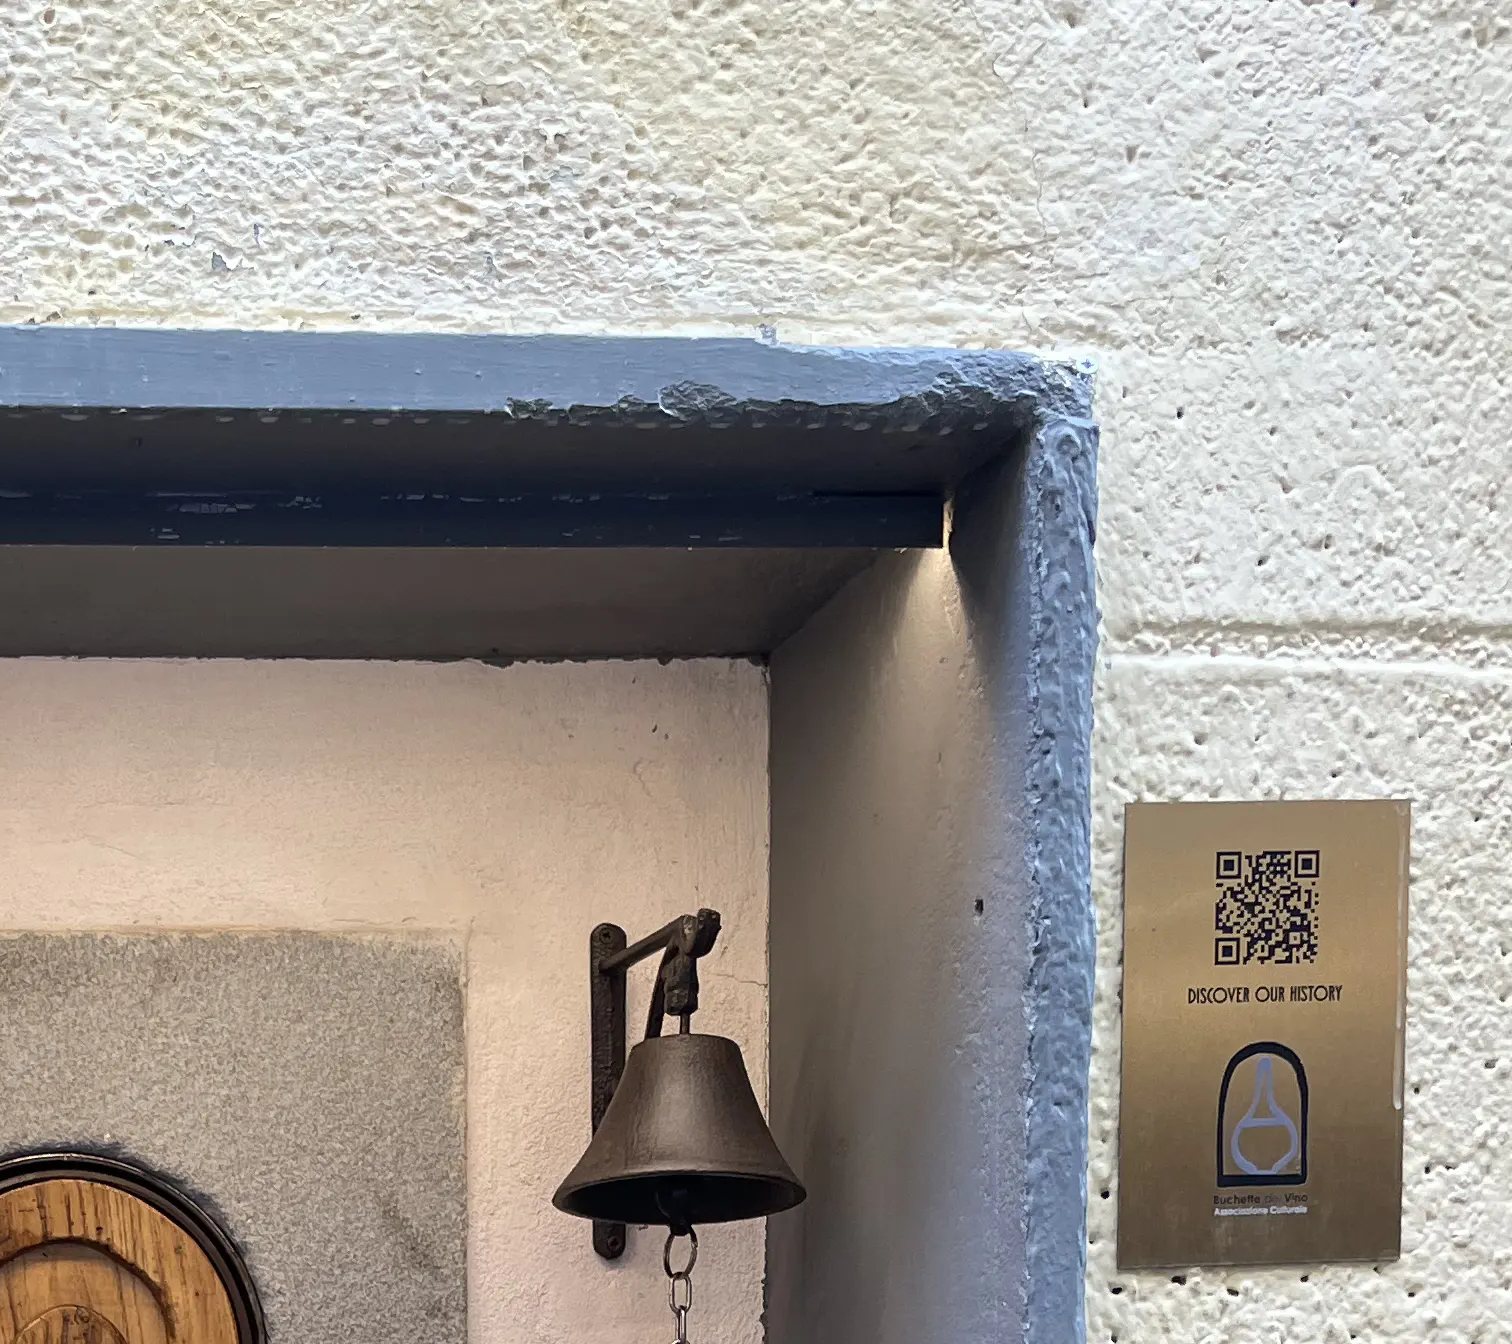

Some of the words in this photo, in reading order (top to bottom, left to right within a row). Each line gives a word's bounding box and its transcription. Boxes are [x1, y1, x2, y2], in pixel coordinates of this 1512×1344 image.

[1188, 987, 1249, 1004] DISCOVER
[1255, 986, 1285, 1003] OUR
[1290, 985, 1342, 1002] HISTORY
[1284, 1192, 1308, 1203] Vino
